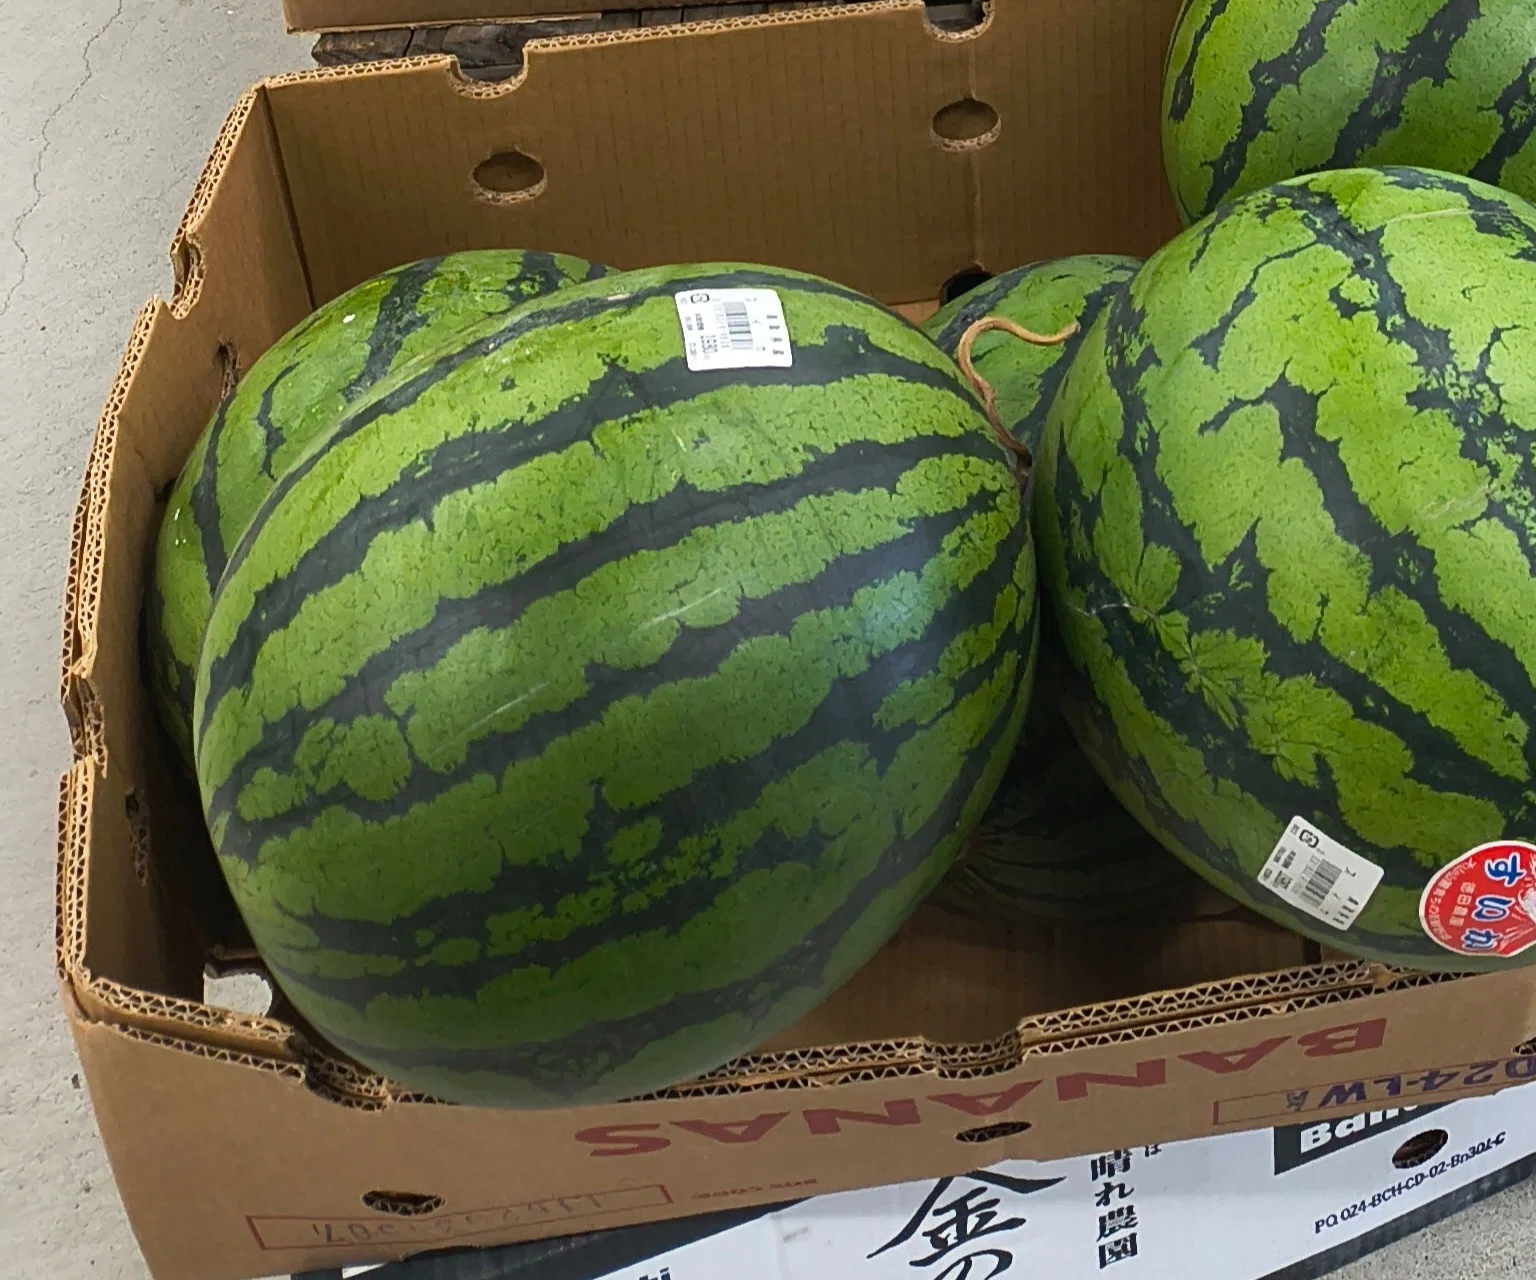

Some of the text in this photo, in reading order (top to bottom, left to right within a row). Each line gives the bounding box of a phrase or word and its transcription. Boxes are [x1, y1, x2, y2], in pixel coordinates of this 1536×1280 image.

[1463, 852, 1526, 951] すいか
[574, 1018, 1387, 1158] BANANAS
[1090, 1149, 1138, 1269] 晴れ農園
